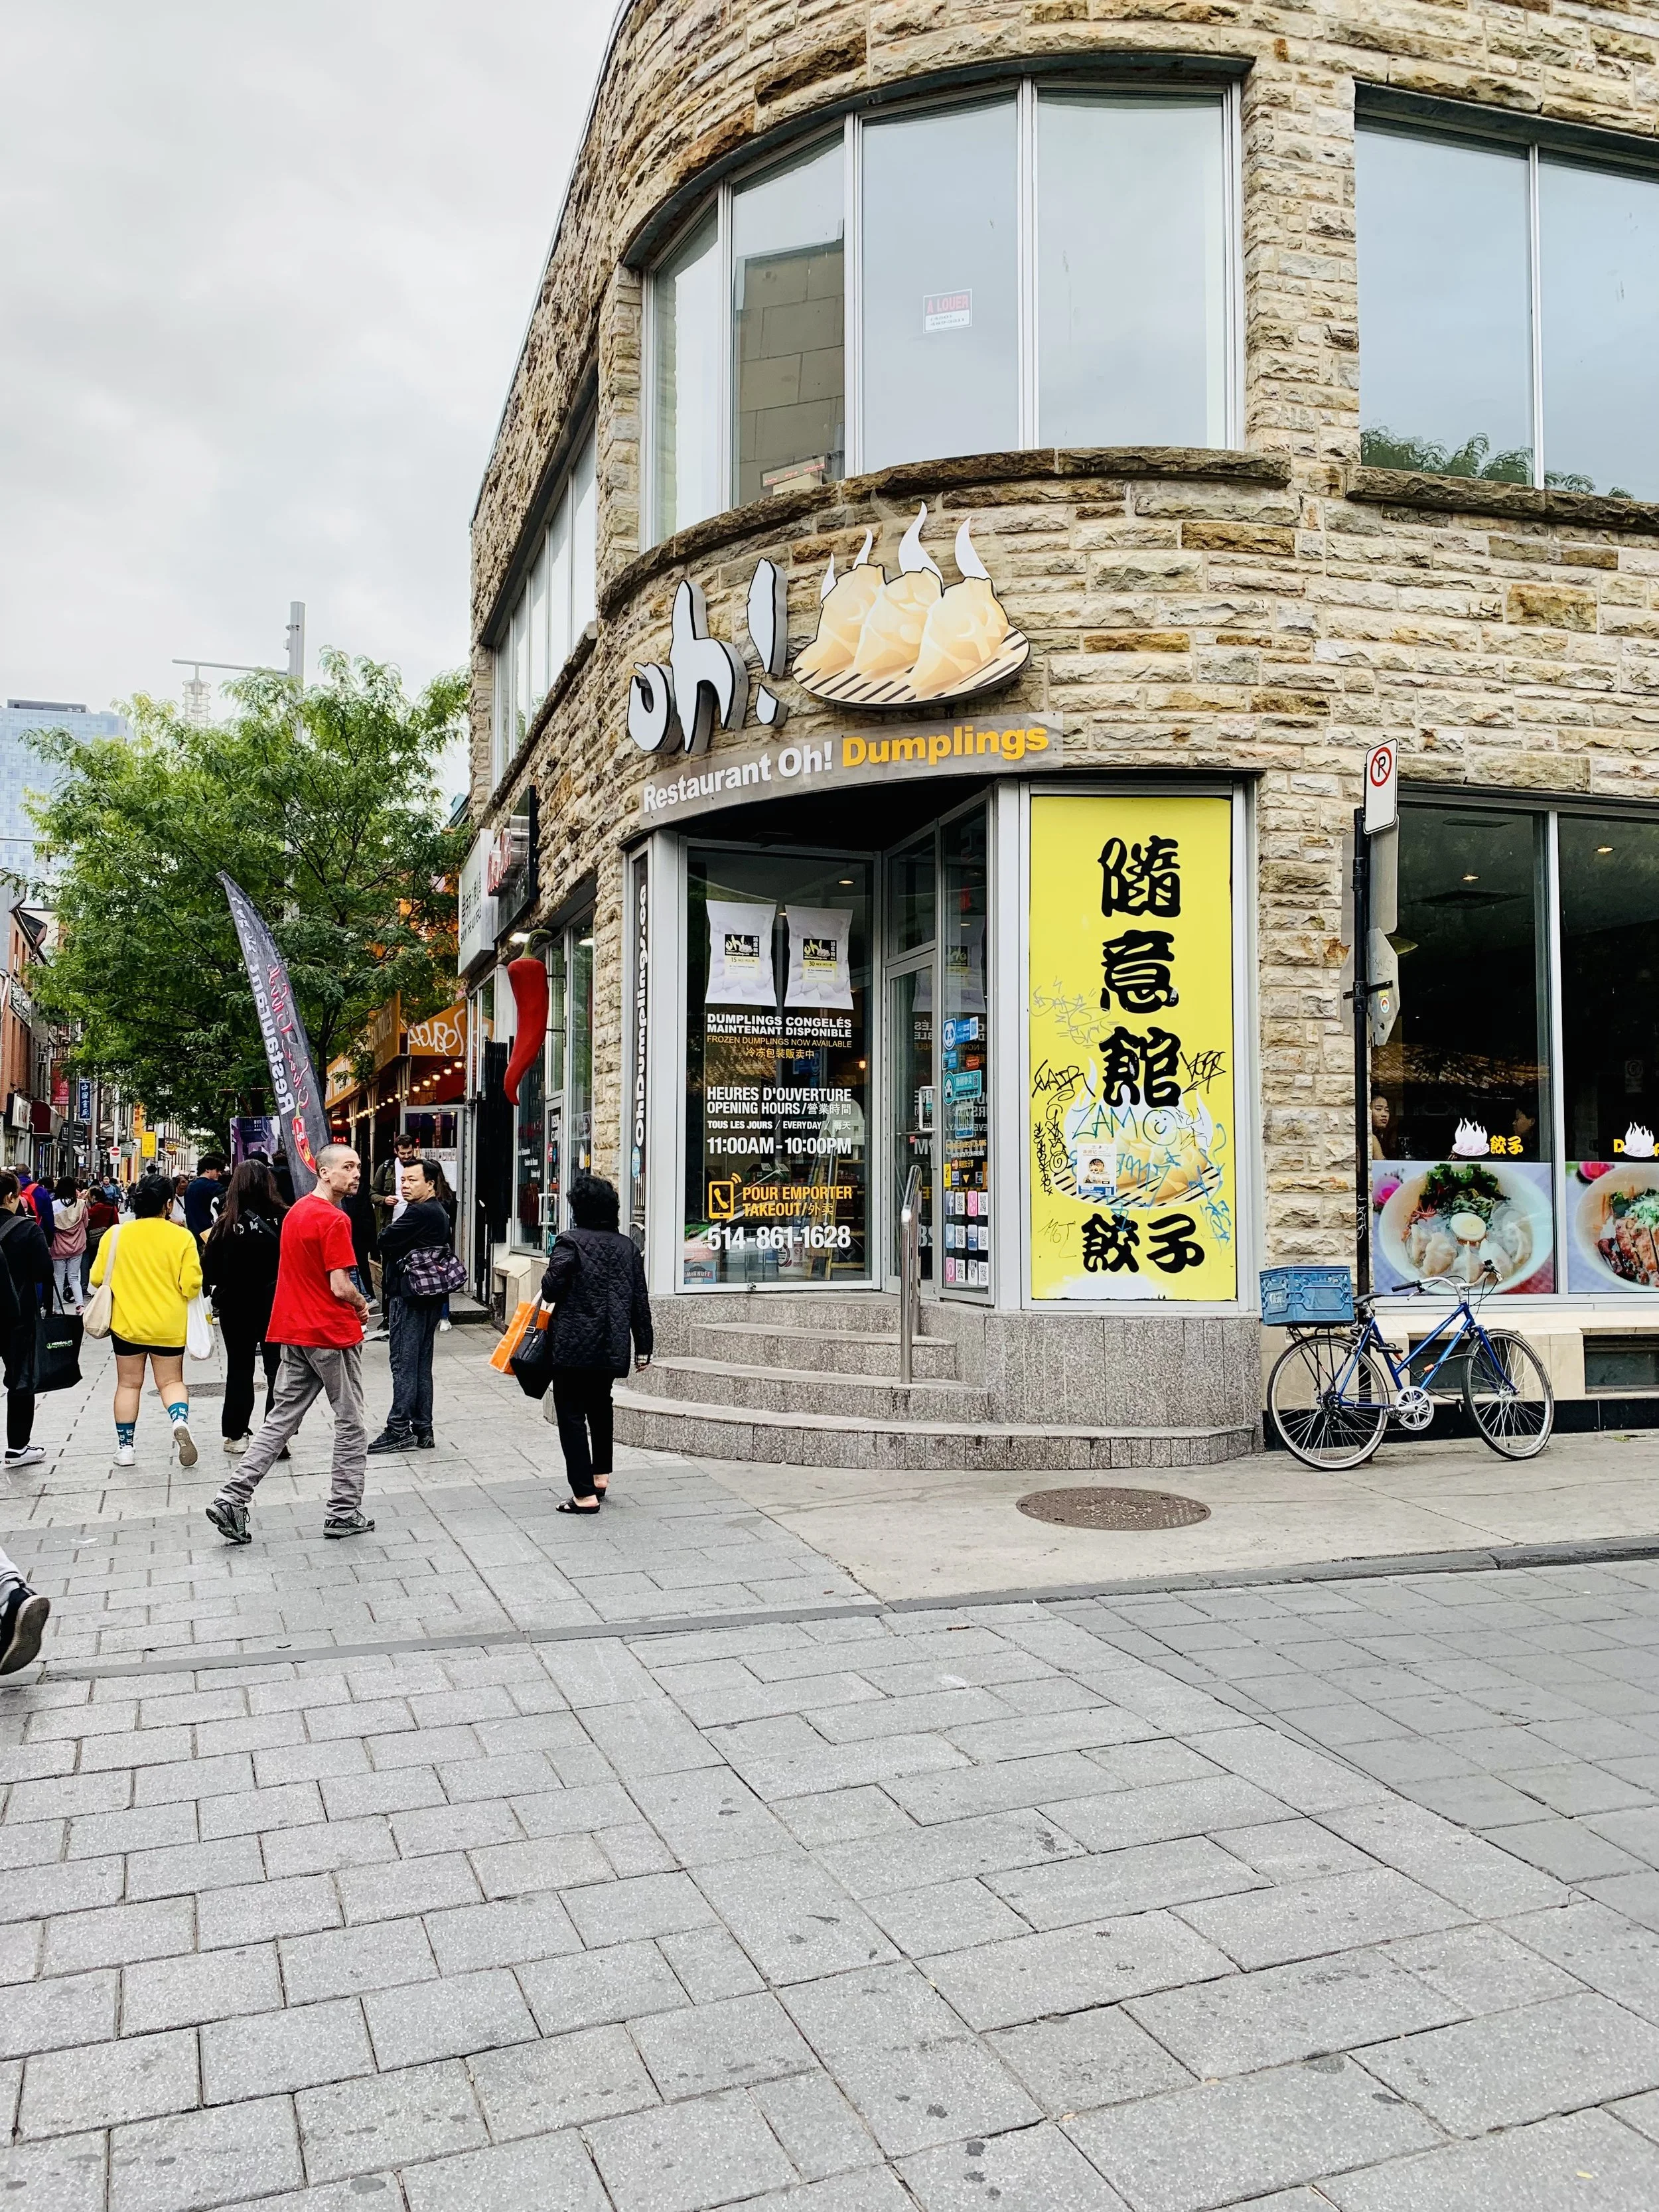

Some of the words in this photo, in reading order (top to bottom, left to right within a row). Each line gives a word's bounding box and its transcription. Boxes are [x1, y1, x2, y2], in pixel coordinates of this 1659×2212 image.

[937, 295, 969, 313] LOUER
[643, 753, 771, 814] Restaurant
[778, 740, 833, 780] Oh!
[842, 725, 1048, 768] Dumplings
[635, 885, 648, 1147] OhDumplings.ca
[707, 1013, 782, 1026] DUMPLINGS
[786, 1017, 852, 1028] CONGELÉS
[707, 1024, 783, 1035] MAINTENANT
[786, 1027, 852, 1037] DISPONIBLE
[707, 1035, 741, 1044] FROZEN
[812, 1039, 852, 1048] AVAILABLE
[707, 1086, 759, 1100] HEURES
[763, 1087, 852, 1102] D'OUVERTURE
[707, 1102, 758, 1114] OPENING
[707, 1120, 729, 1129] TOUS
[730, 1120, 745, 1129] LES
[783, 1121, 822, 1130] EVERYDAY
[1489, 1135, 1524, 1155] 餃子
[742, 1186, 778, 1200] POUR
[782, 1185, 853, 1200] EMPORTER
[707, 1225, 851, 1250] 514-861-1628
[1081, 1213, 1205, 1273] 餃子
